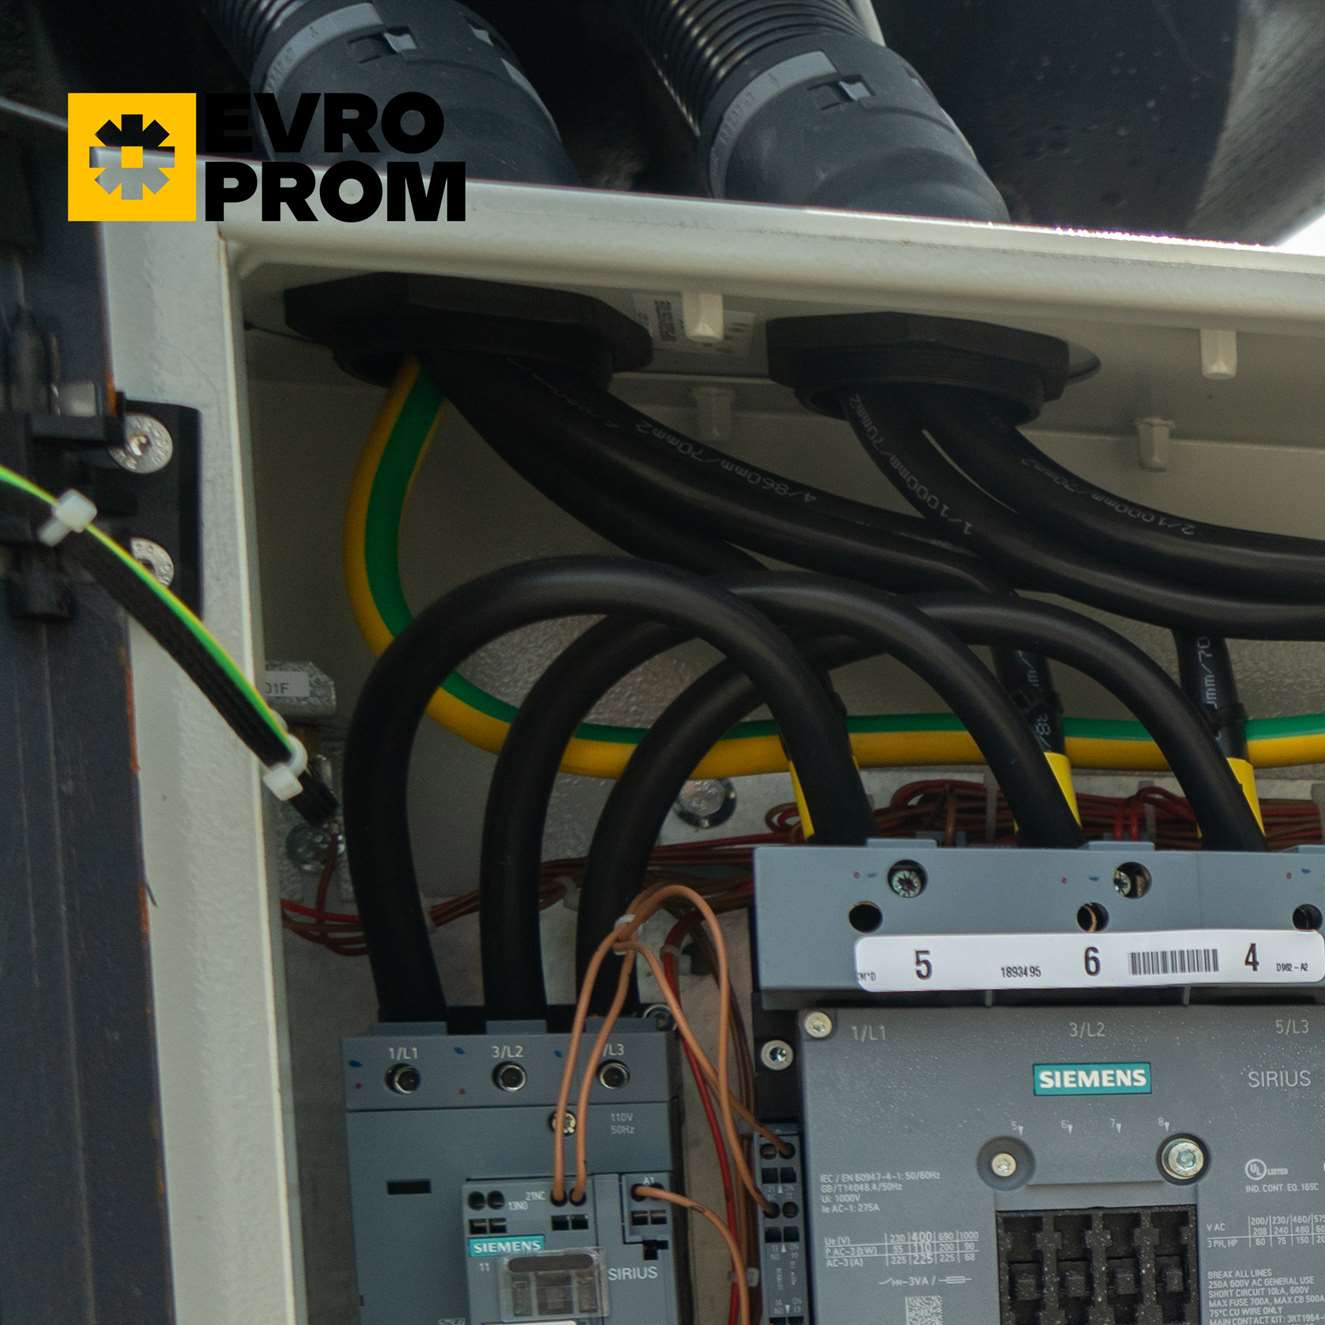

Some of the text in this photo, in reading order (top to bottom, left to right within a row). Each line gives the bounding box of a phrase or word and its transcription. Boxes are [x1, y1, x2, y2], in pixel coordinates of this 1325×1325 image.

[915, 950, 932, 979] 5
[1001, 966, 1042, 978] 1893495
[1084, 947, 1100, 976] 6
[1244, 943, 1259, 971] 4
[852, 1020, 1309, 1041] 1/L1 3/L2 5/L3
[390, 1044, 624, 1059] 1/L1 3/L2 /L3
[1039, 1069, 1311, 1088] SIEMENS SIRIUS
[474, 1241, 541, 1253] SIEMENS
[608, 1267, 658, 1281] SIRIUS
